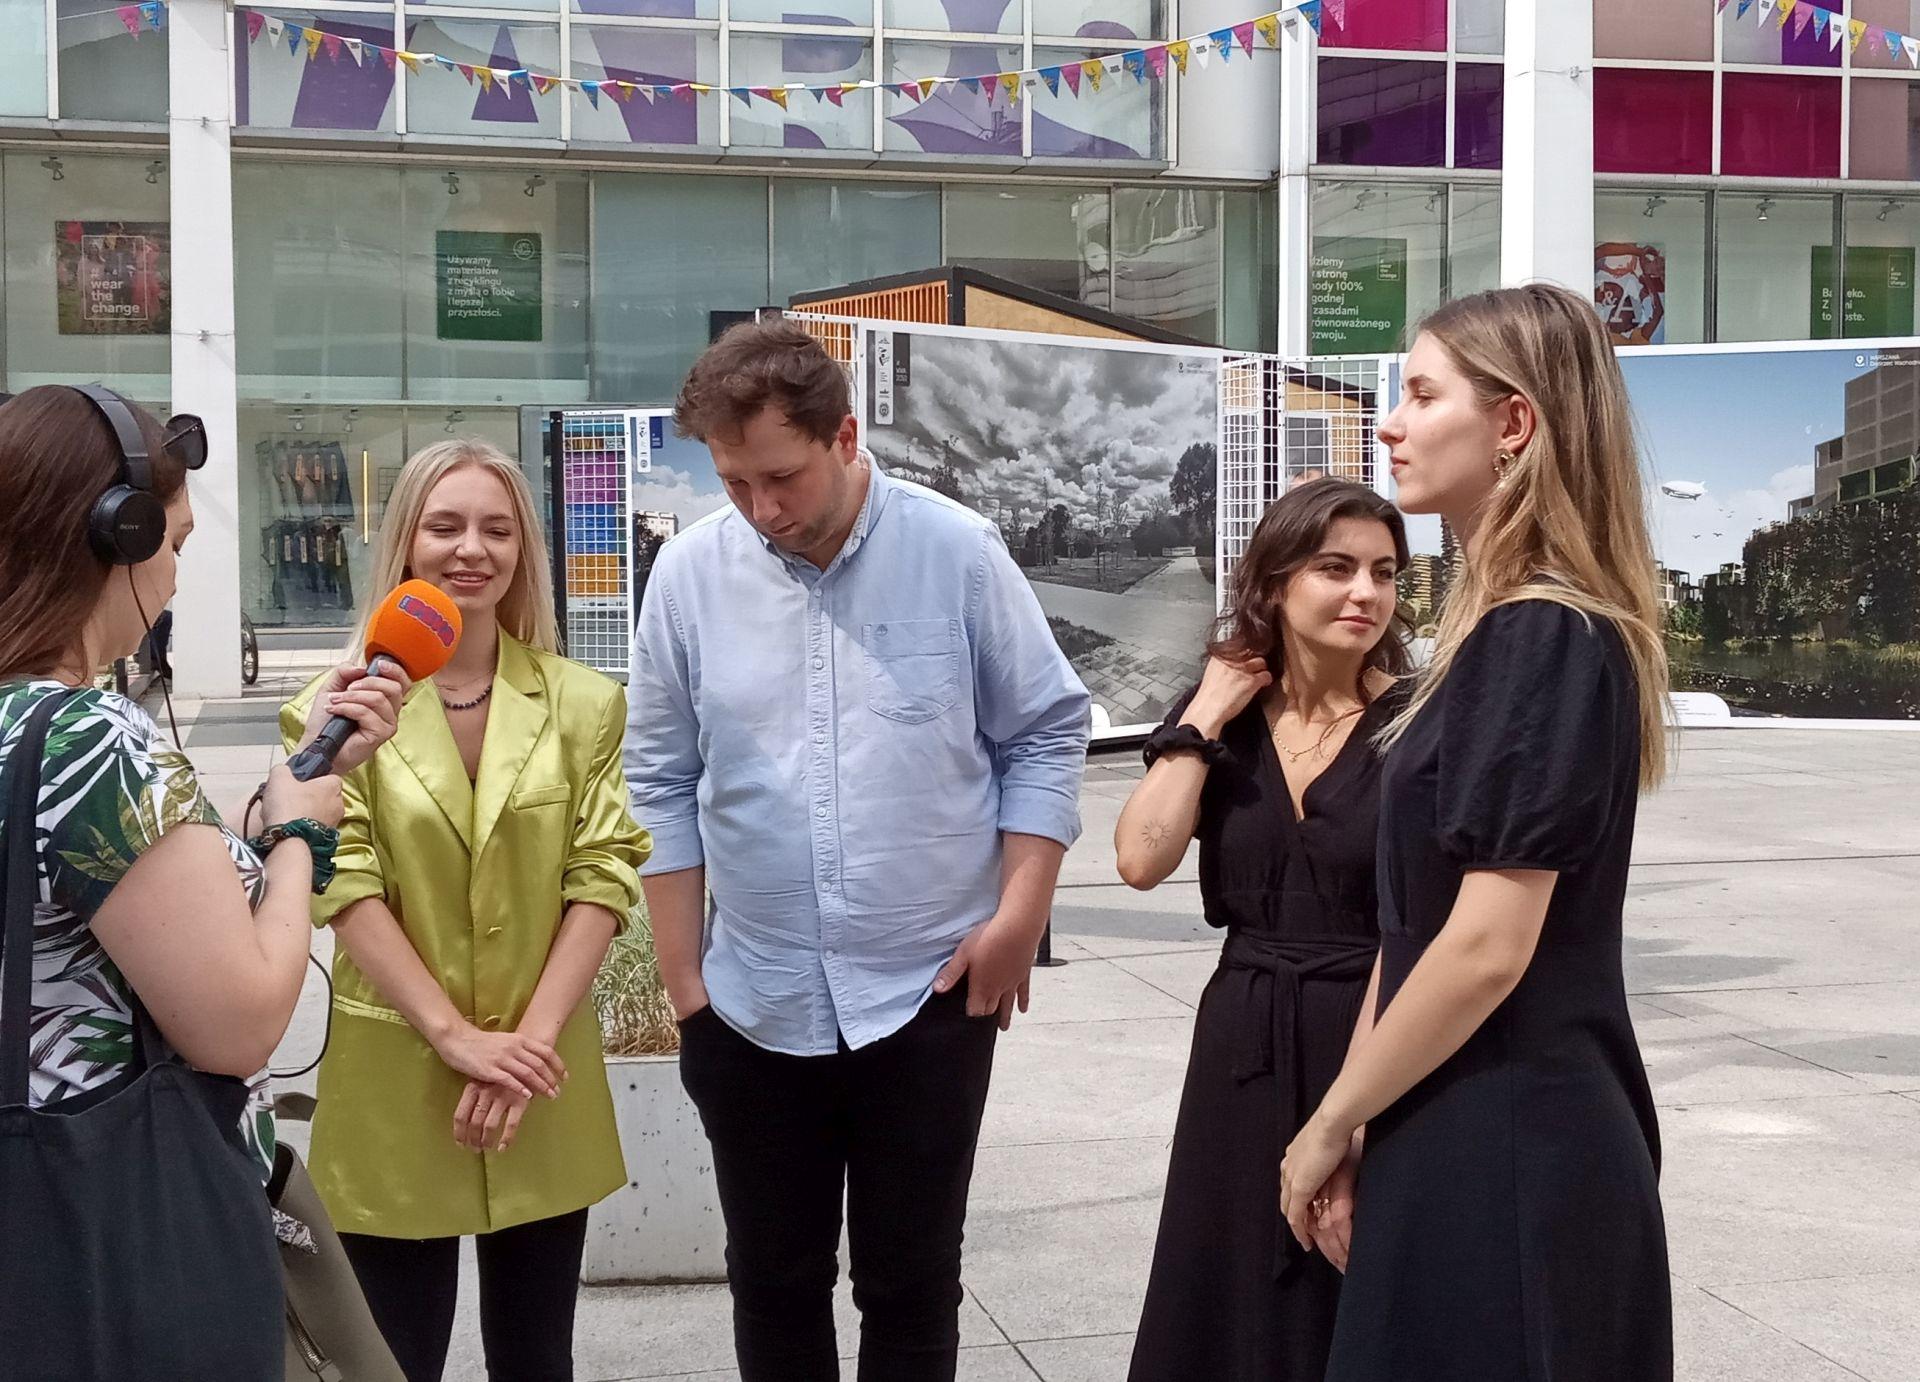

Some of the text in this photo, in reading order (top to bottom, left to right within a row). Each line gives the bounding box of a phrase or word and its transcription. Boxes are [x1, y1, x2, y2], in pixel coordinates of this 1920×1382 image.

[91, 280, 124, 289] wear
[1335, 281, 1364, 292] 100%
[91, 290, 113, 301] the
[1846, 288, 1866, 298] eko.
[91, 303, 140, 316] change
[447, 308, 502, 318] przyszłości.
[1313, 305, 1359, 316] zasadami
[1821, 312, 1832, 321] to
